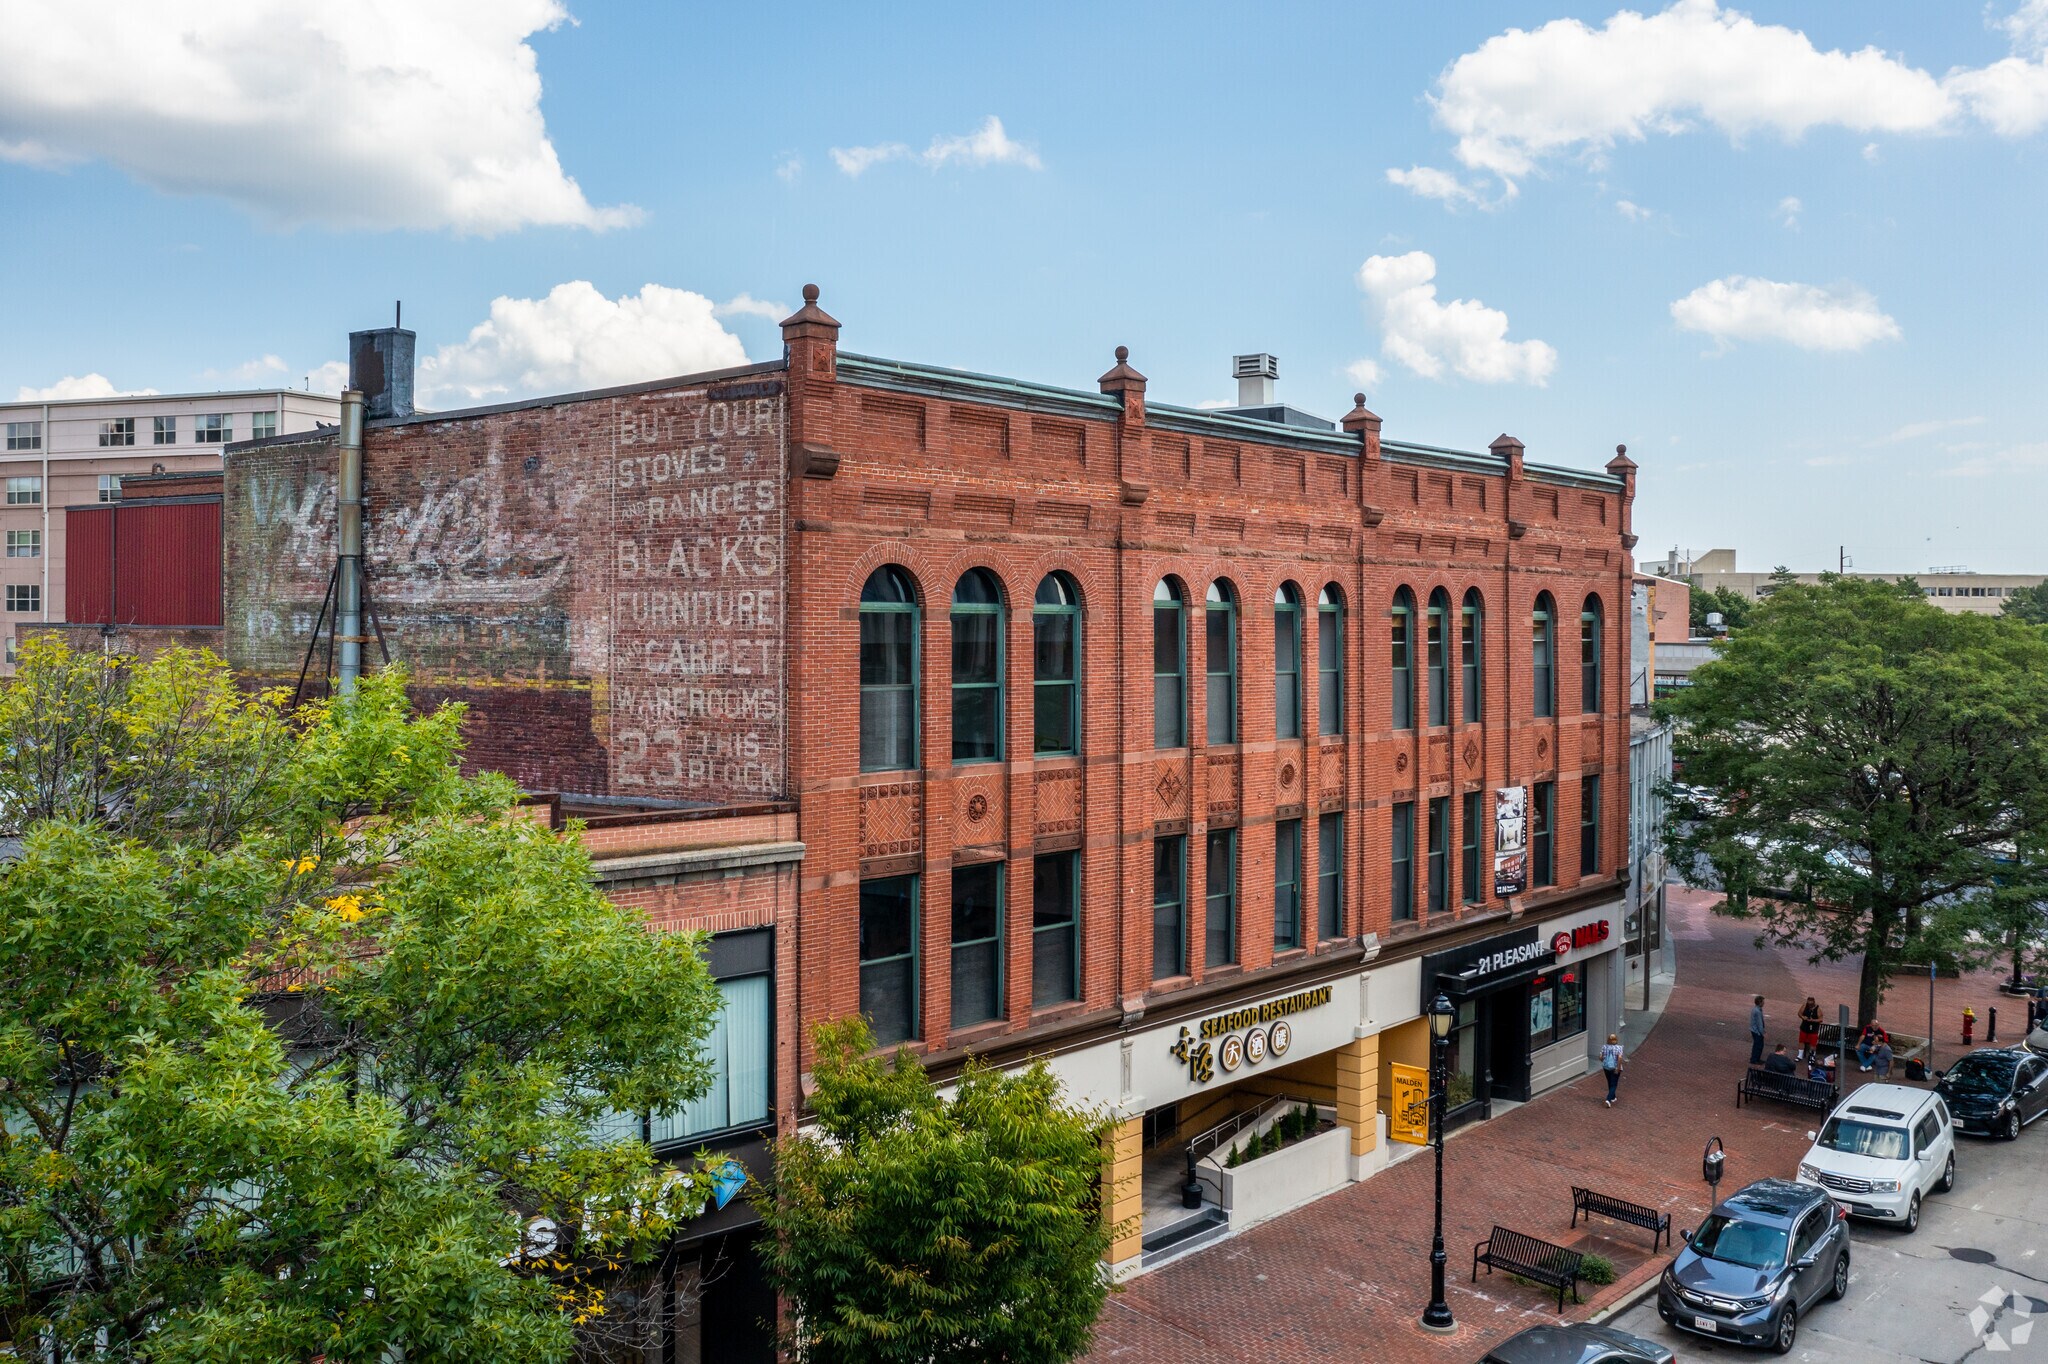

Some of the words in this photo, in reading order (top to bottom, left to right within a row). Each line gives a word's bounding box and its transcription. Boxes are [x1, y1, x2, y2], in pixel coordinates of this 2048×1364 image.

[686, 398, 775, 438] YOUR
[619, 443, 726, 488] STOVES
[649, 480, 775, 527] RANGES
[738, 516, 765, 532] AT
[617, 590, 774, 627] FURNITURE
[646, 638, 775, 675] CARPET
[618, 728, 682, 786] 23
[1573, 919, 1609, 949] NAILS
[1478, 957, 1491, 975] 21
[1493, 940, 1545, 970] PLEASANT
[1200, 1008, 1259, 1039] SEAFOOD
[1260, 985, 1333, 1022] RESTAURANT
[1396, 1077, 1423, 1088] MALDEN
